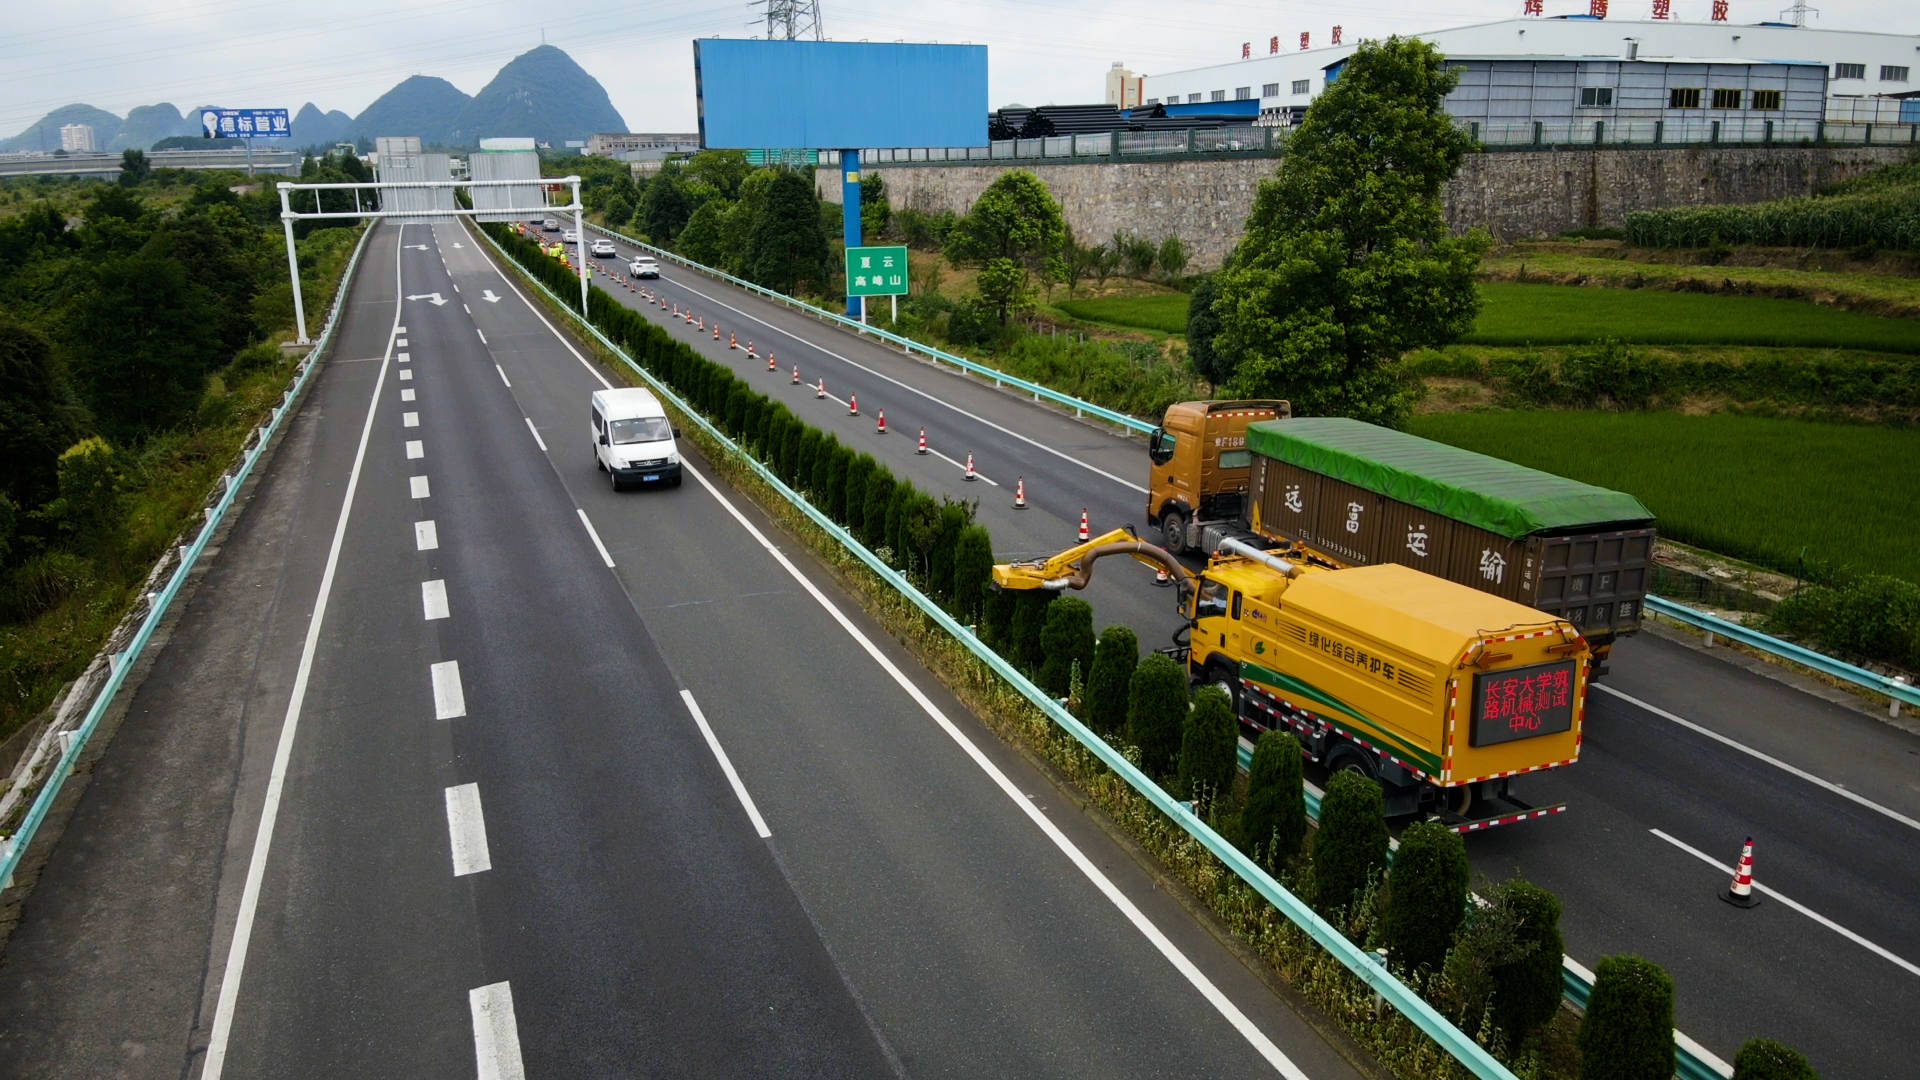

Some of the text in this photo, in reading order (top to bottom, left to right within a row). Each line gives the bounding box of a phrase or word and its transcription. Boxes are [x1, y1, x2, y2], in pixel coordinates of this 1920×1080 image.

[1524, 0, 1729, 22] 辉腾塑胶
[1242, 25, 1342, 60] 辉腾塑胶
[860, 256, 894, 269] 夏云
[855, 274, 902, 287] 高峰山
[1308, 631, 1395, 681] 绿化综合养护车
[1483, 689, 1569, 720] 路机械测试
[1509, 714, 1542, 733] 中心
